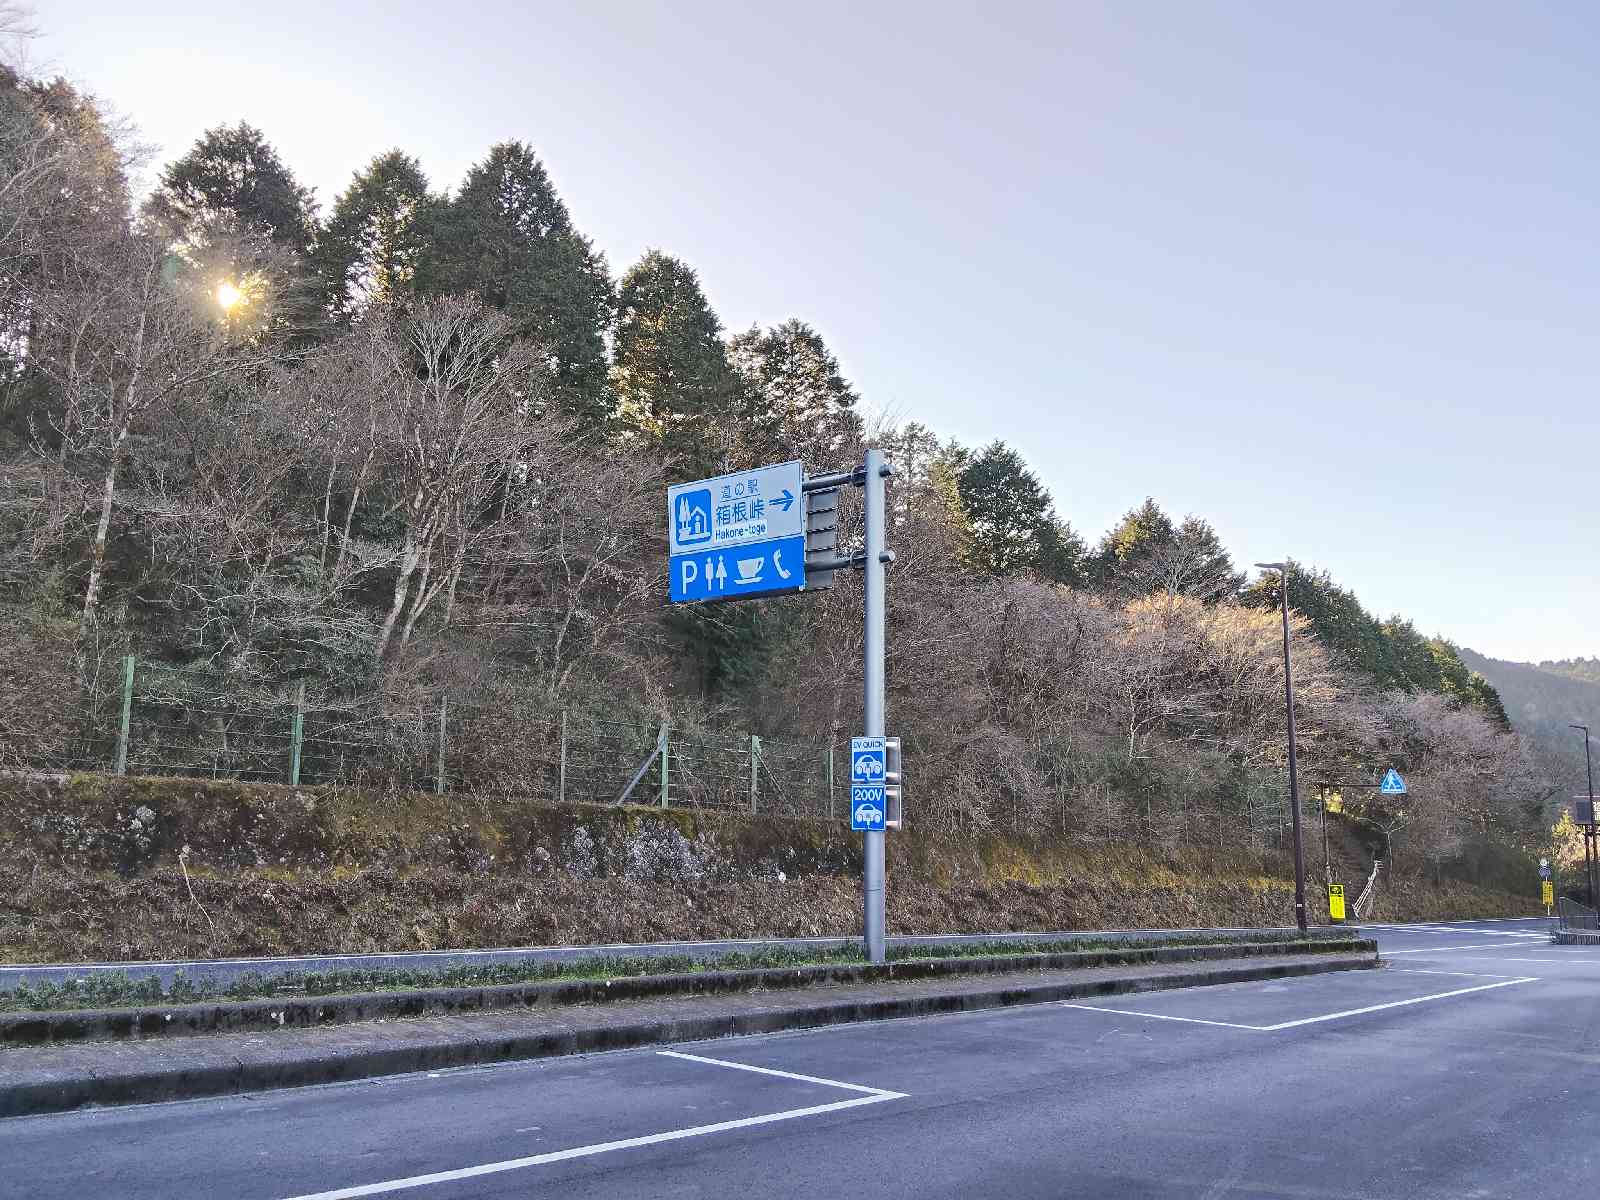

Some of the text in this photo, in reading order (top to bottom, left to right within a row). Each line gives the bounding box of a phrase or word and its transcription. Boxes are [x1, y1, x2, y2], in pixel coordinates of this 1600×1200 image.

[720, 479, 759, 499] 道の駅
[716, 499, 765, 526] 箱根峠
[681, 560, 698, 595] P
[863, 740, 884, 749] QUICK
[854, 788, 882, 801] 200V
